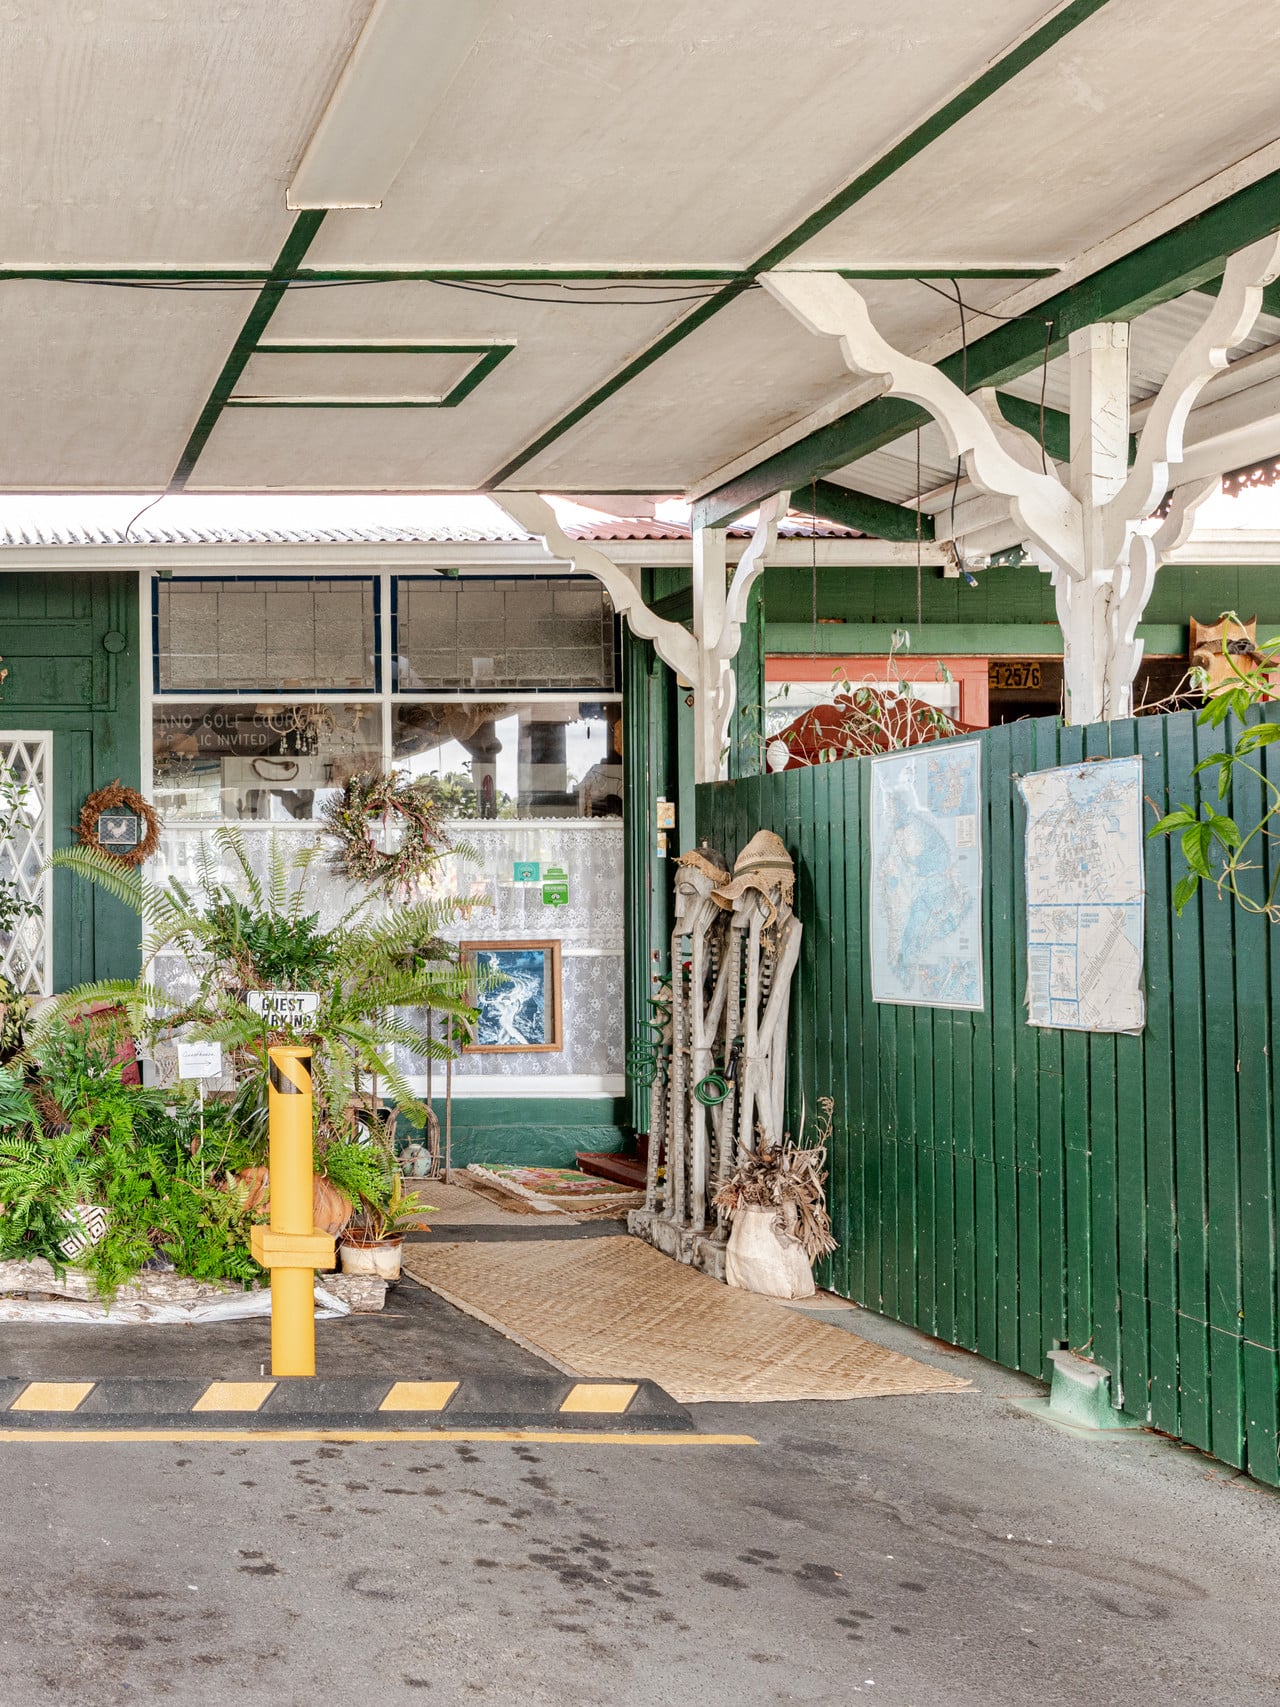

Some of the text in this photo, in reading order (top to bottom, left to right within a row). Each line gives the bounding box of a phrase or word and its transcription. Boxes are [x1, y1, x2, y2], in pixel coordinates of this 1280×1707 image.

[153, 714, 193, 728] ANO
[202, 714, 244, 728] GOLF
[217, 734, 267, 746] INVITED
[261, 998, 305, 1012] GUEST
